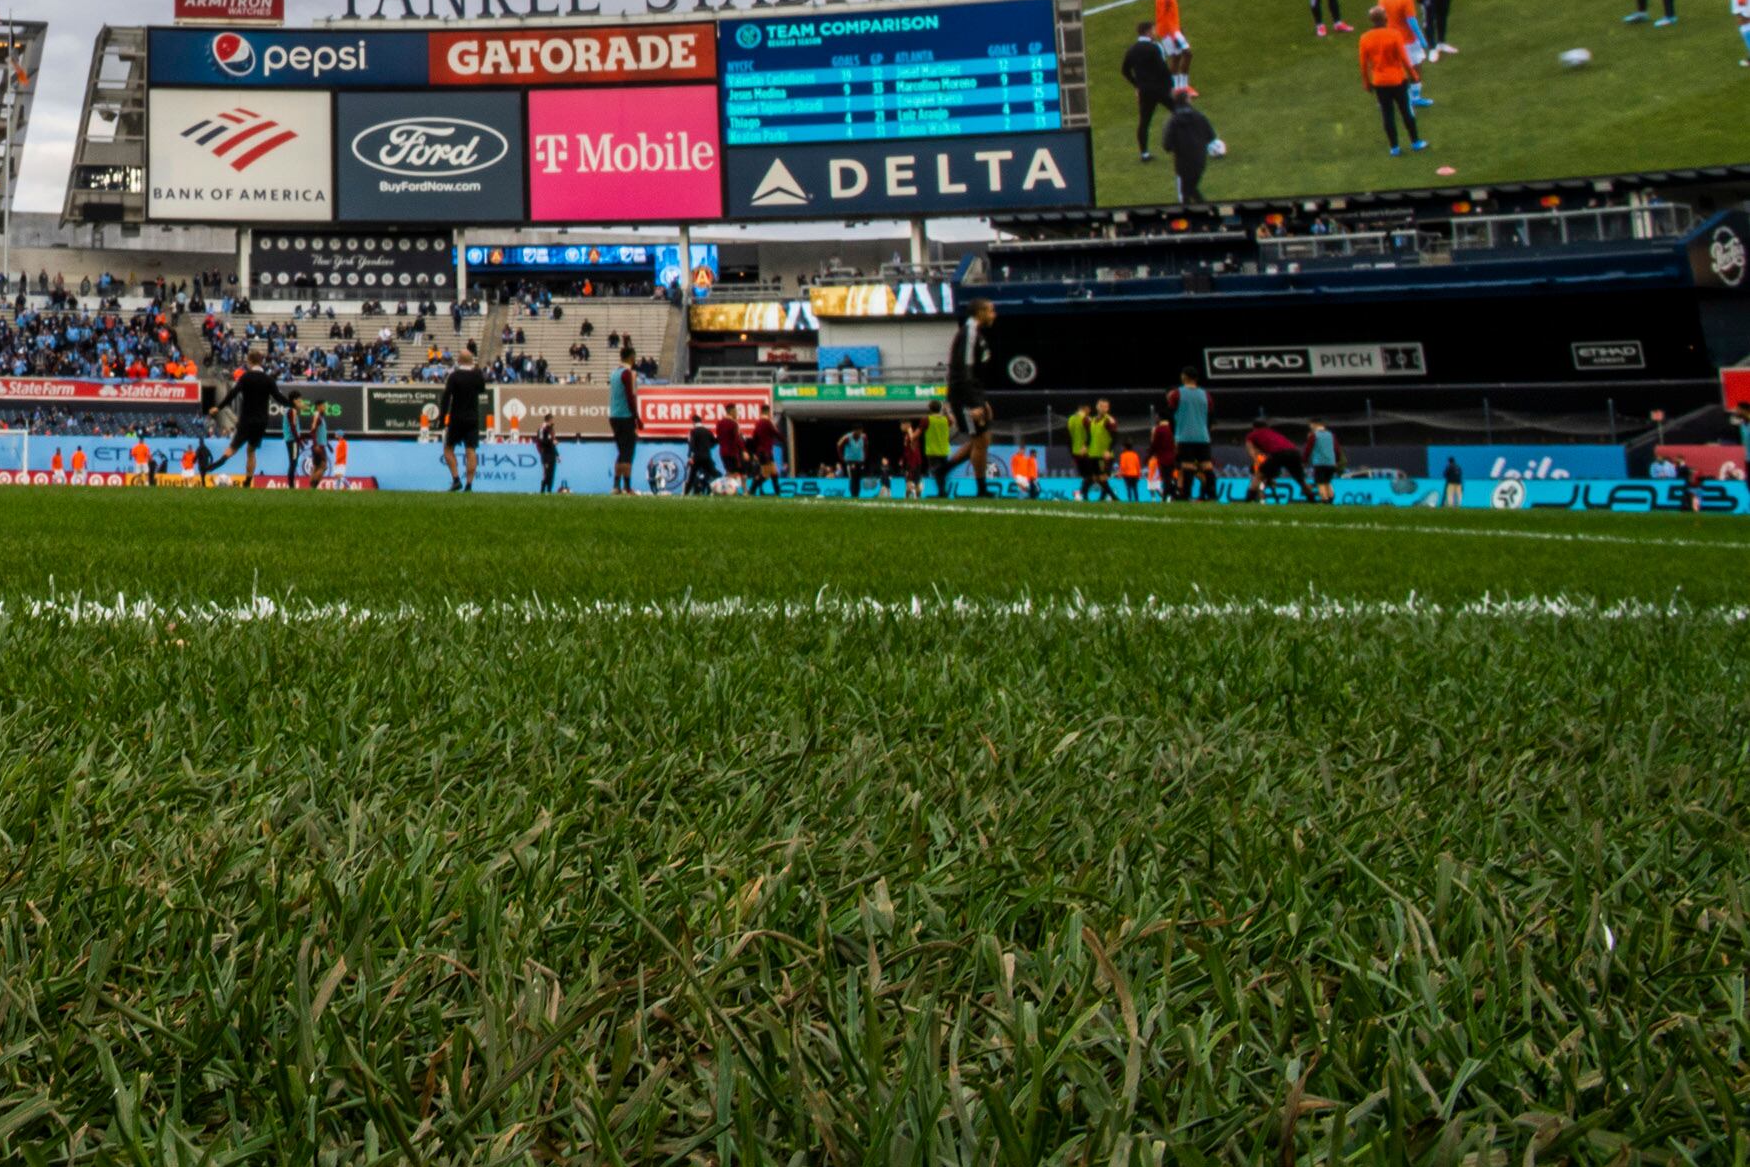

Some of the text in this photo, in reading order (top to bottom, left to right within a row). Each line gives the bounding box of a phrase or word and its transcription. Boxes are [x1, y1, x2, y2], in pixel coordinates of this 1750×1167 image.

[228, 7, 272, 16] WATCHES
[766, 15, 940, 39] TEAM COMPARISON
[263, 40, 366, 78] pepsi
[447, 33, 696, 75] GATORADE
[831, 54, 860, 67] GOALS
[895, 50, 934, 63] ATLANTA
[987, 43, 1018, 57] GOALS
[1028, 41, 1043, 54] GP
[730, 117, 761, 130] Thiago
[379, 125, 479, 167] Ford
[576, 131, 714, 172] Mobile
[828, 148, 1067, 200] DELTA
[379, 181, 481, 193] BuyFordNow.com
[153, 188, 326, 202] BANK OF AMERICA
[356, 254, 395, 270] Yankees
[1578, 347, 1636, 357] ETIHAD
[1213, 351, 1373, 369] ETIHAD PITCH
[415, 392, 436, 400] Circle
[778, 385, 818, 397] bet365
[846, 386, 886, 397] bet365
[299, 399, 342, 416] Ets
[530, 404, 611, 417] LOTTE HOT
[266, 479, 300, 489] Aui
[461, 472, 517, 481] ARWAYS
[1530, 483, 1740, 514] JLAB
